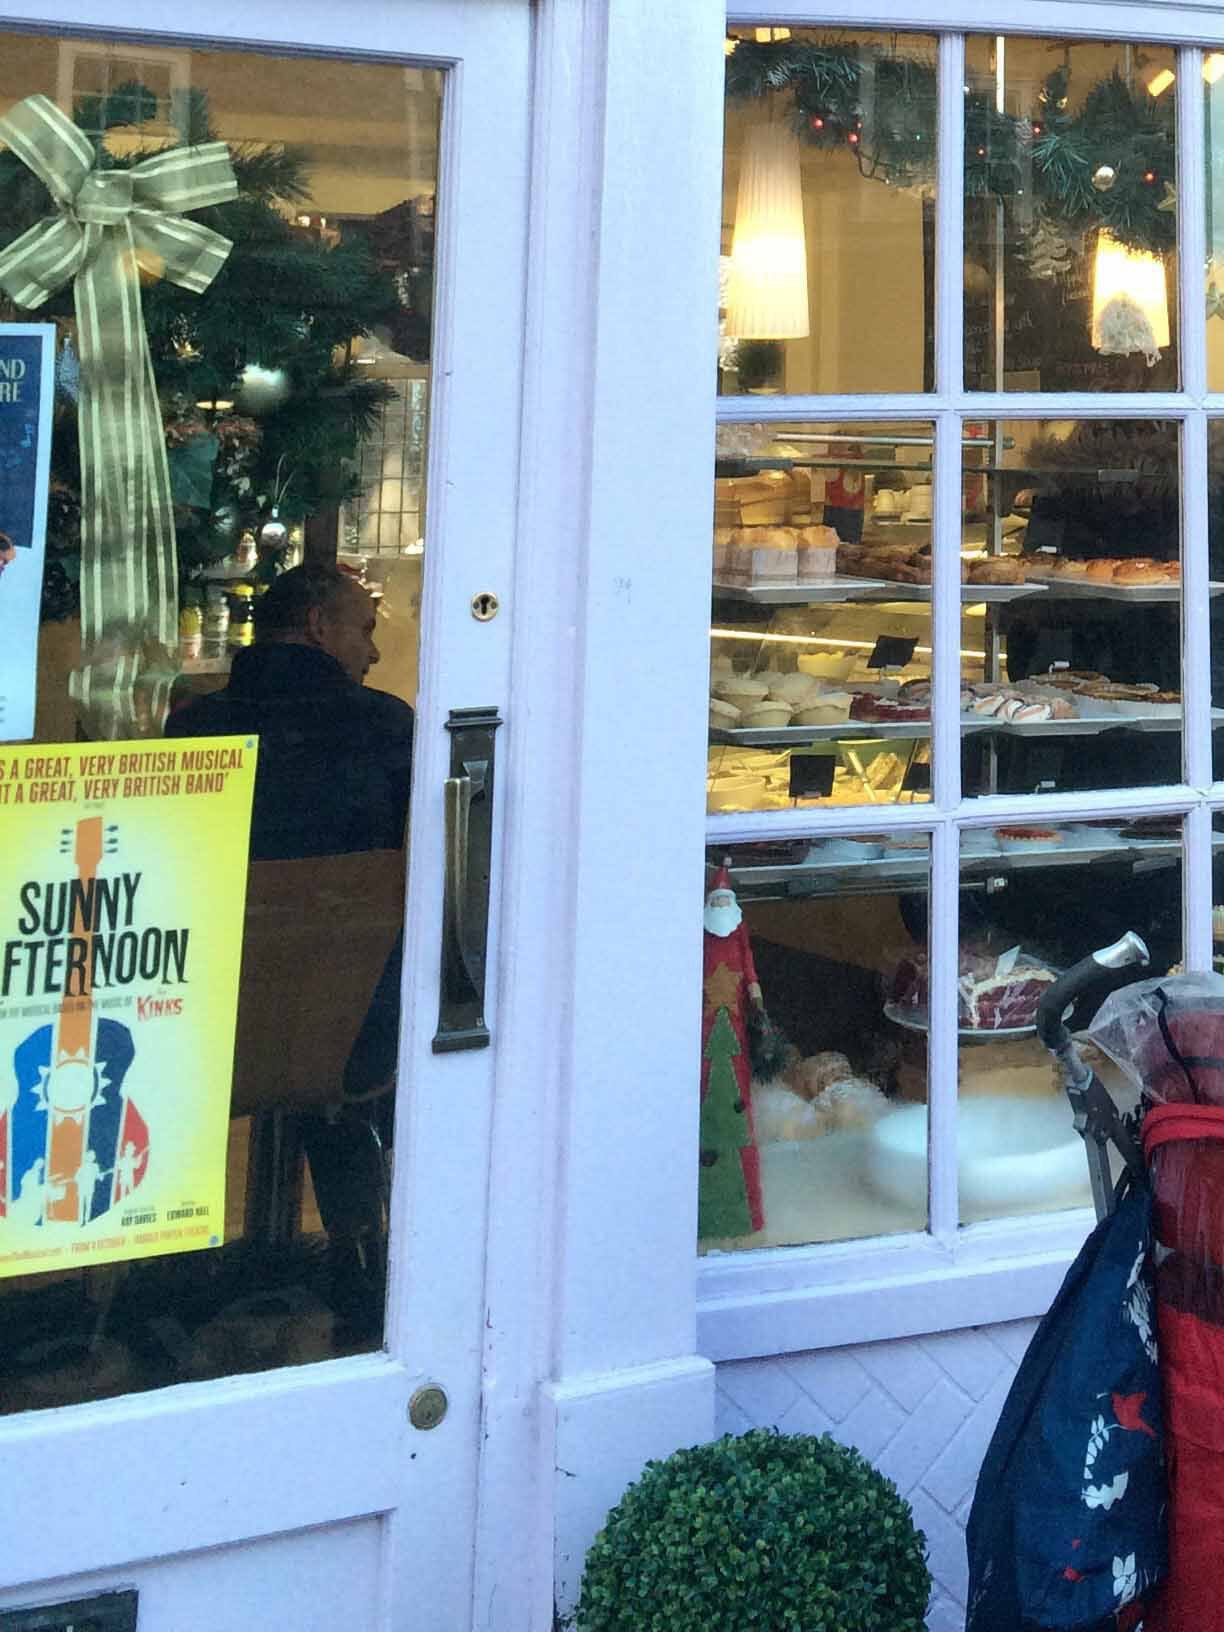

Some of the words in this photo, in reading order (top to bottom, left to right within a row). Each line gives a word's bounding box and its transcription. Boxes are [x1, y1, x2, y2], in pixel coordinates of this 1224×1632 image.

[10, 759, 19, 779] A
[25, 756, 73, 779] GREAT,
[79, 754, 120, 777] VERY
[118, 751, 177, 774] BRITISH
[181, 748, 244, 771] MUSICAL
[15, 782, 24, 803] A
[29, 779, 78, 803] GREAT,
[83, 777, 120, 800] VERY
[123, 775, 181, 798] BRITISH
[18, 871, 143, 937] SUNNY
[1, 926, 190, 998] FTERNOON
[137, 995, 184, 1022] KINKS
